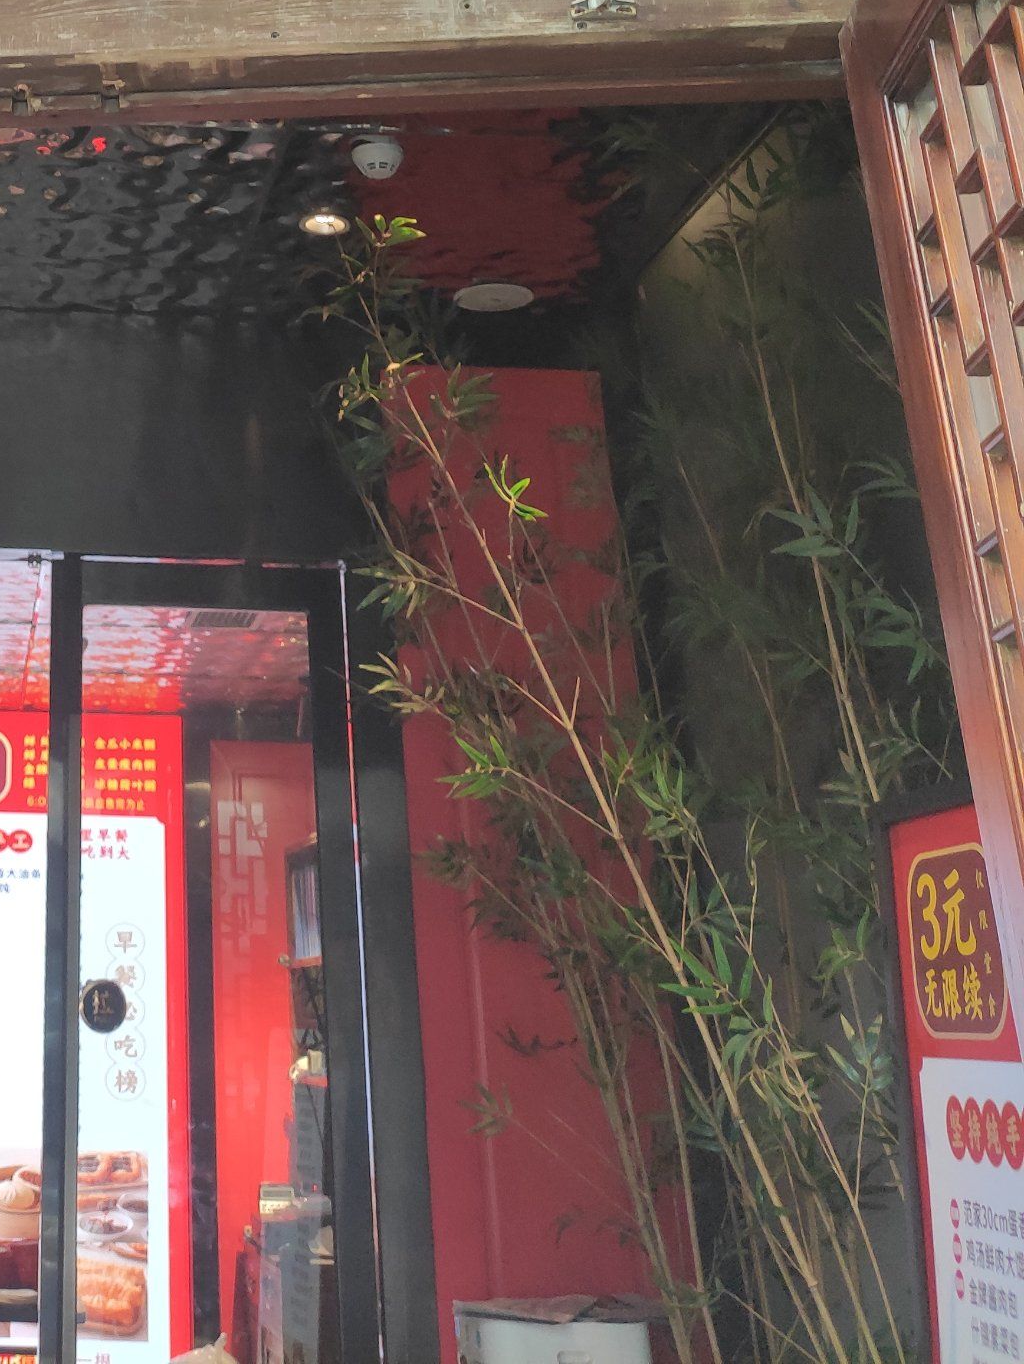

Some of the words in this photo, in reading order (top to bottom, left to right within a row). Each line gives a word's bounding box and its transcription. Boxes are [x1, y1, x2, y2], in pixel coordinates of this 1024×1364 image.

[916, 868, 977, 961] 3元
[924, 961, 984, 1022] 无限续
